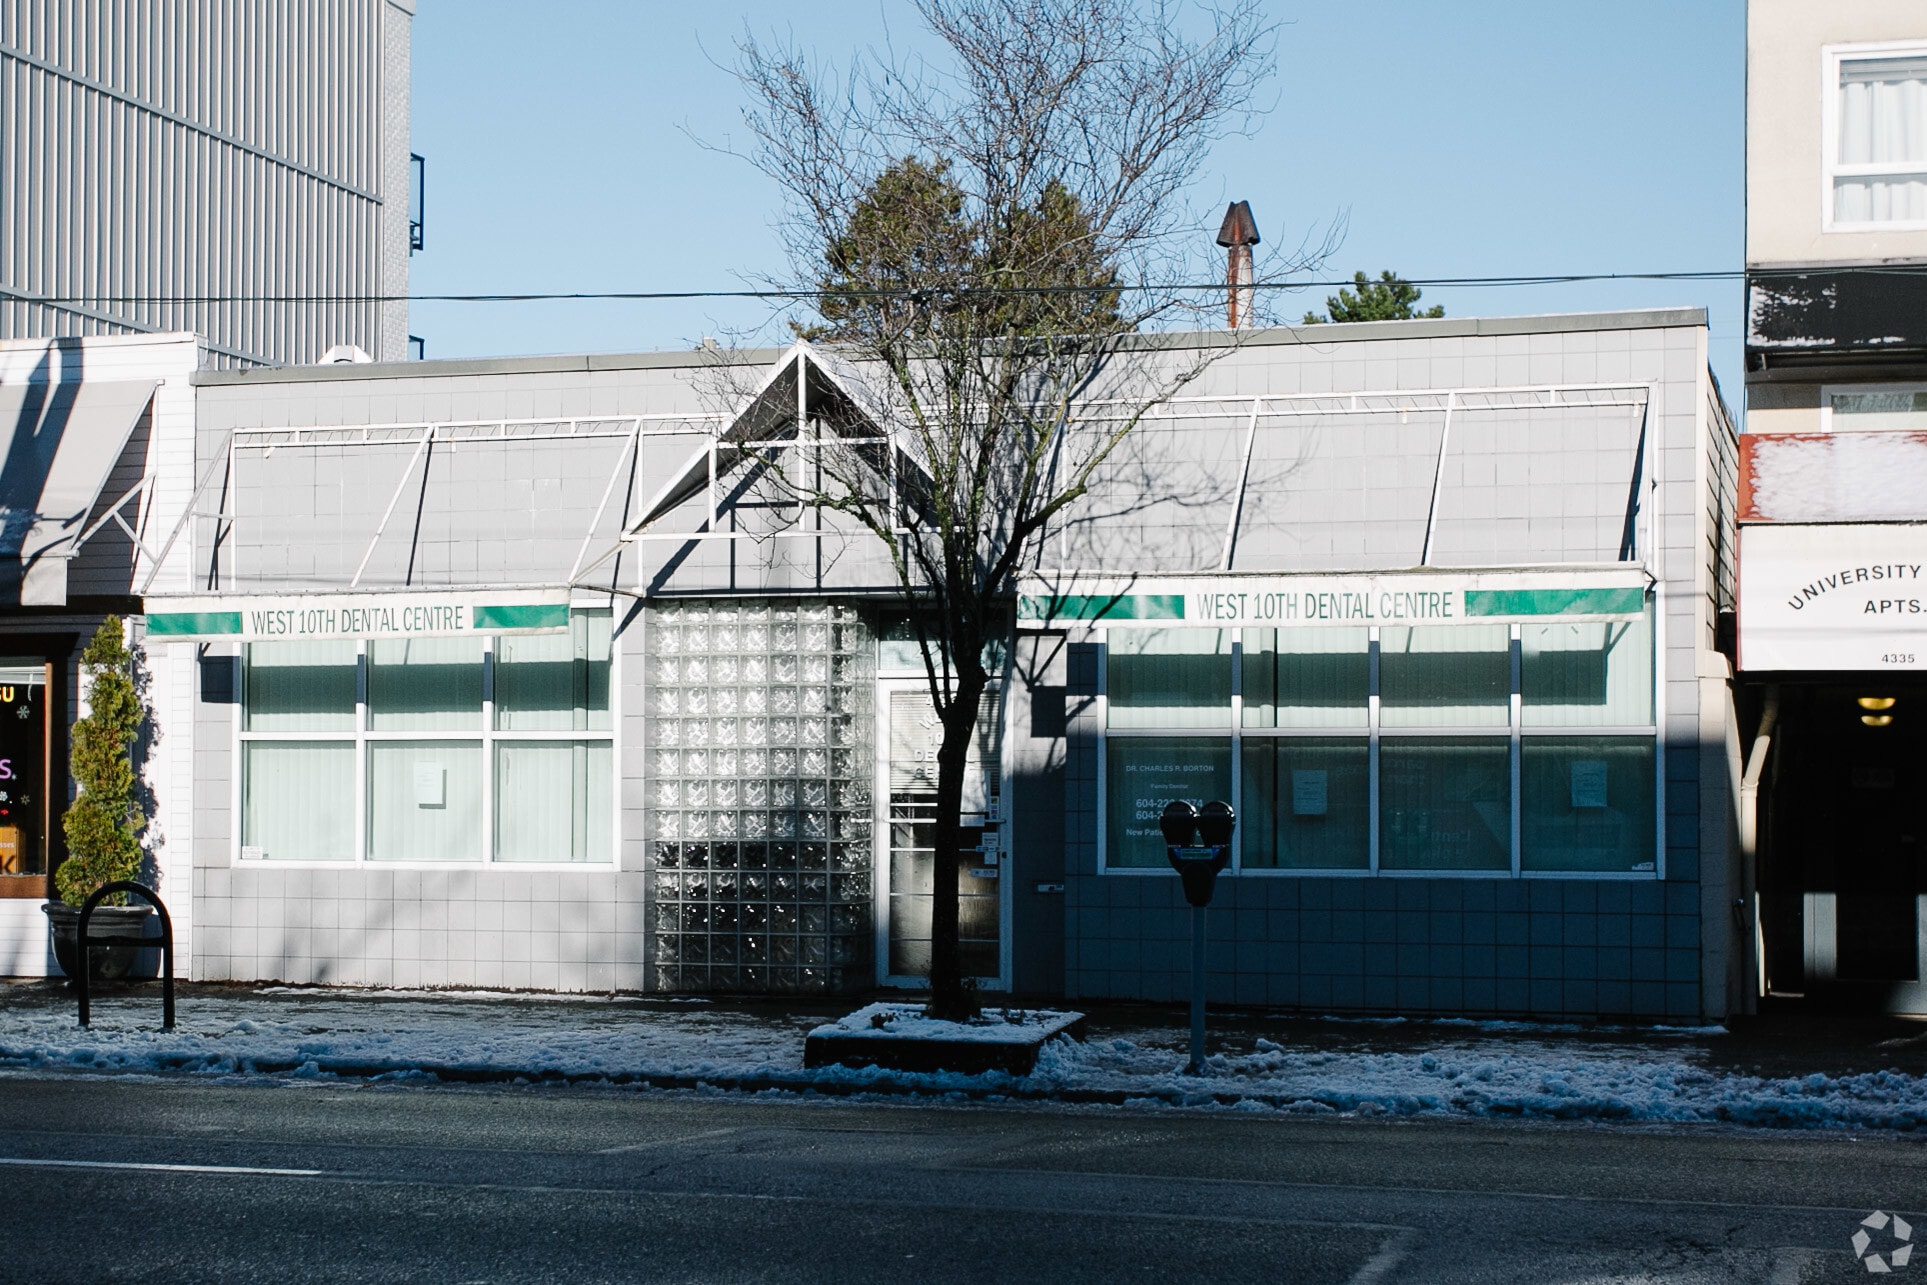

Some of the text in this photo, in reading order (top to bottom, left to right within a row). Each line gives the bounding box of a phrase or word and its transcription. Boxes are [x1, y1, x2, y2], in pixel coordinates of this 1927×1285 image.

[1787, 564, 1922, 611] UNIVERSITY
[251, 605, 464, 635] WEST 10TH DENTAL CENTRE
[1196, 591, 1453, 620] WEST 10TH DENTAL CENTRE
[1863, 599, 1927, 614] APTS.
[1881, 653, 1915, 664] 4335
